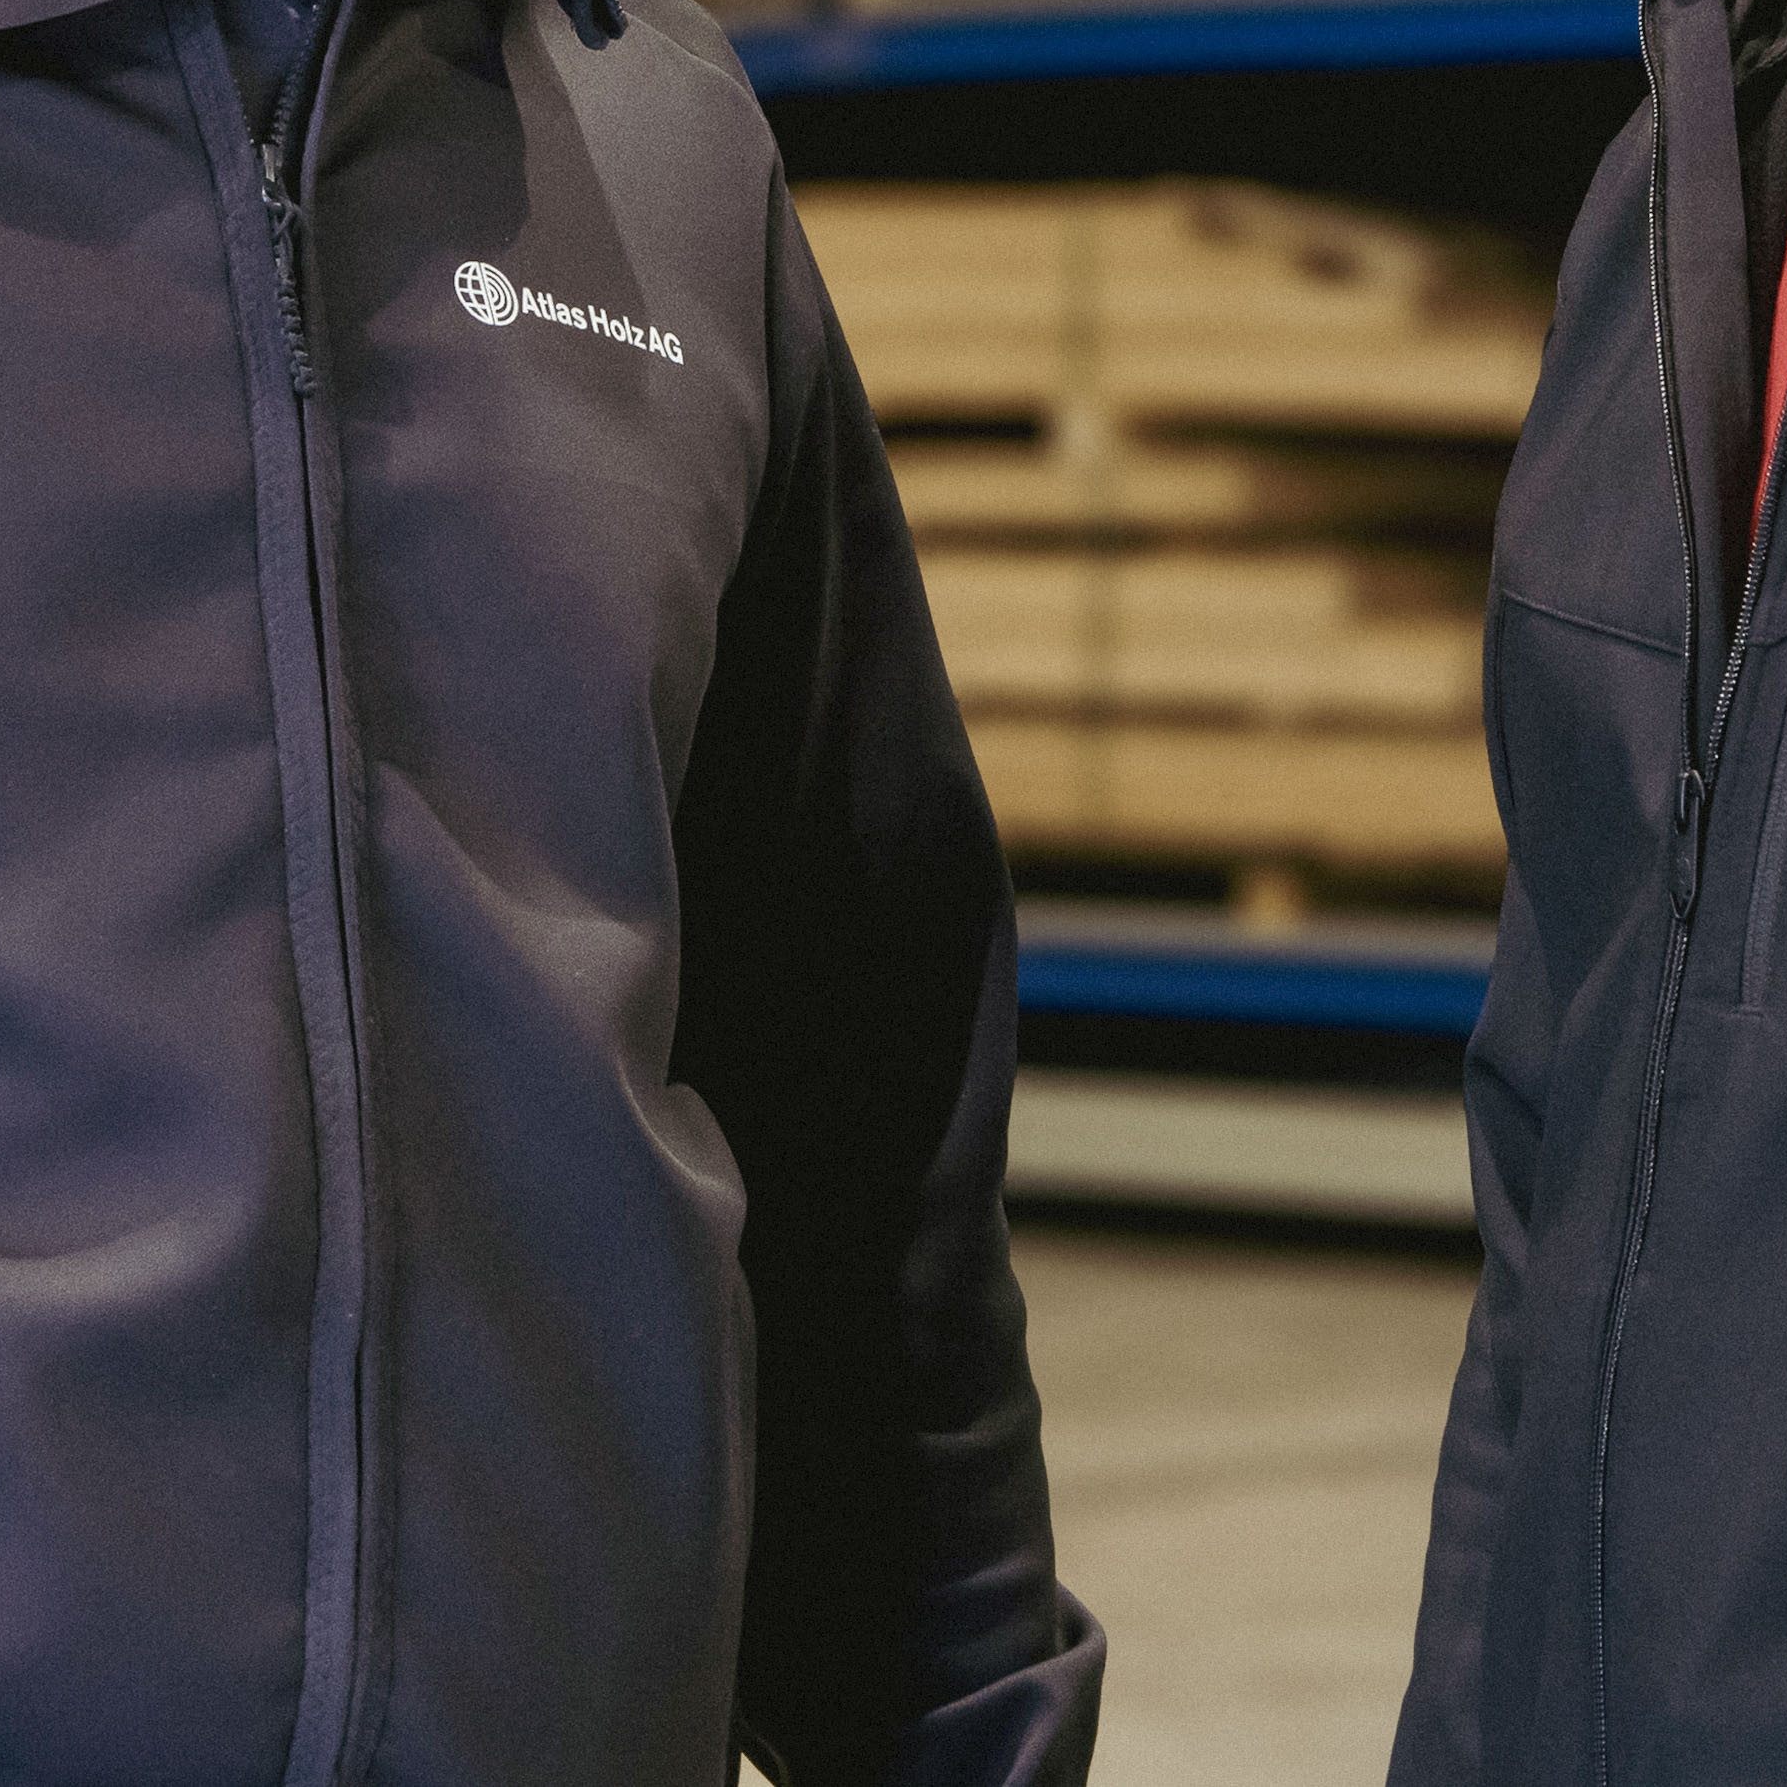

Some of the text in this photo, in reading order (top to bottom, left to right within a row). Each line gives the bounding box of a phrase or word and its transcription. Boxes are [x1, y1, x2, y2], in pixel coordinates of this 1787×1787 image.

[521, 287, 684, 365] Atlas Holz AG
